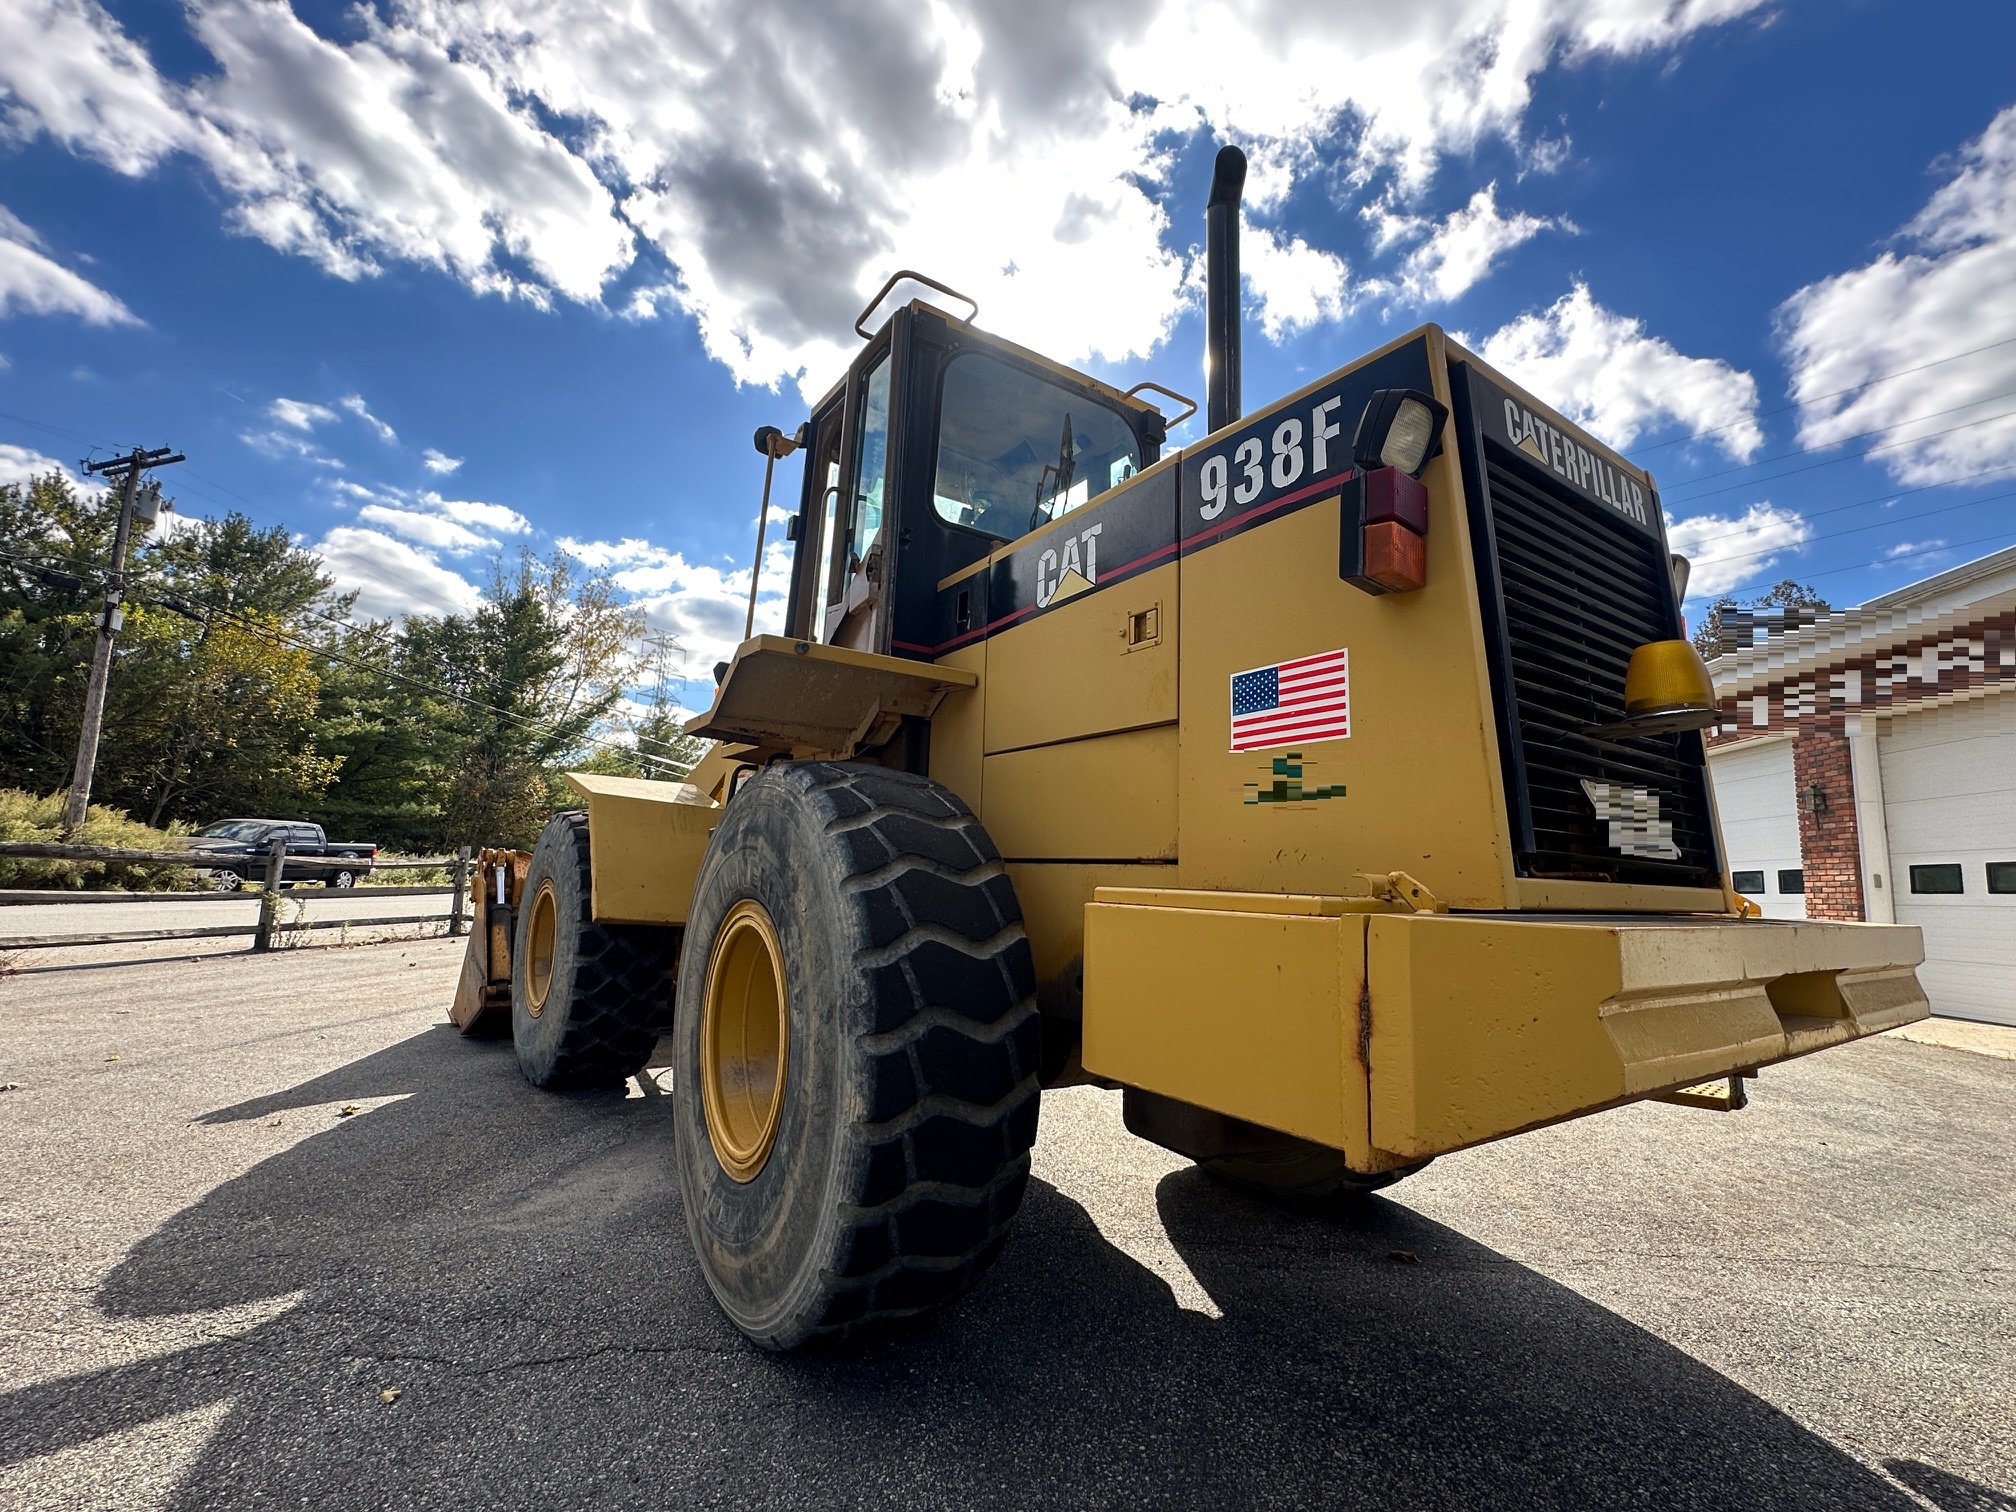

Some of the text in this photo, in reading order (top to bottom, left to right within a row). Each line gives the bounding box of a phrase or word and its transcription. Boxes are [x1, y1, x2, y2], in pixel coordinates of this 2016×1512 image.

[1200, 395, 1341, 520] 938F
[1503, 398, 1647, 526] CATERPILLAR
[1036, 522, 1102, 608] CAT
